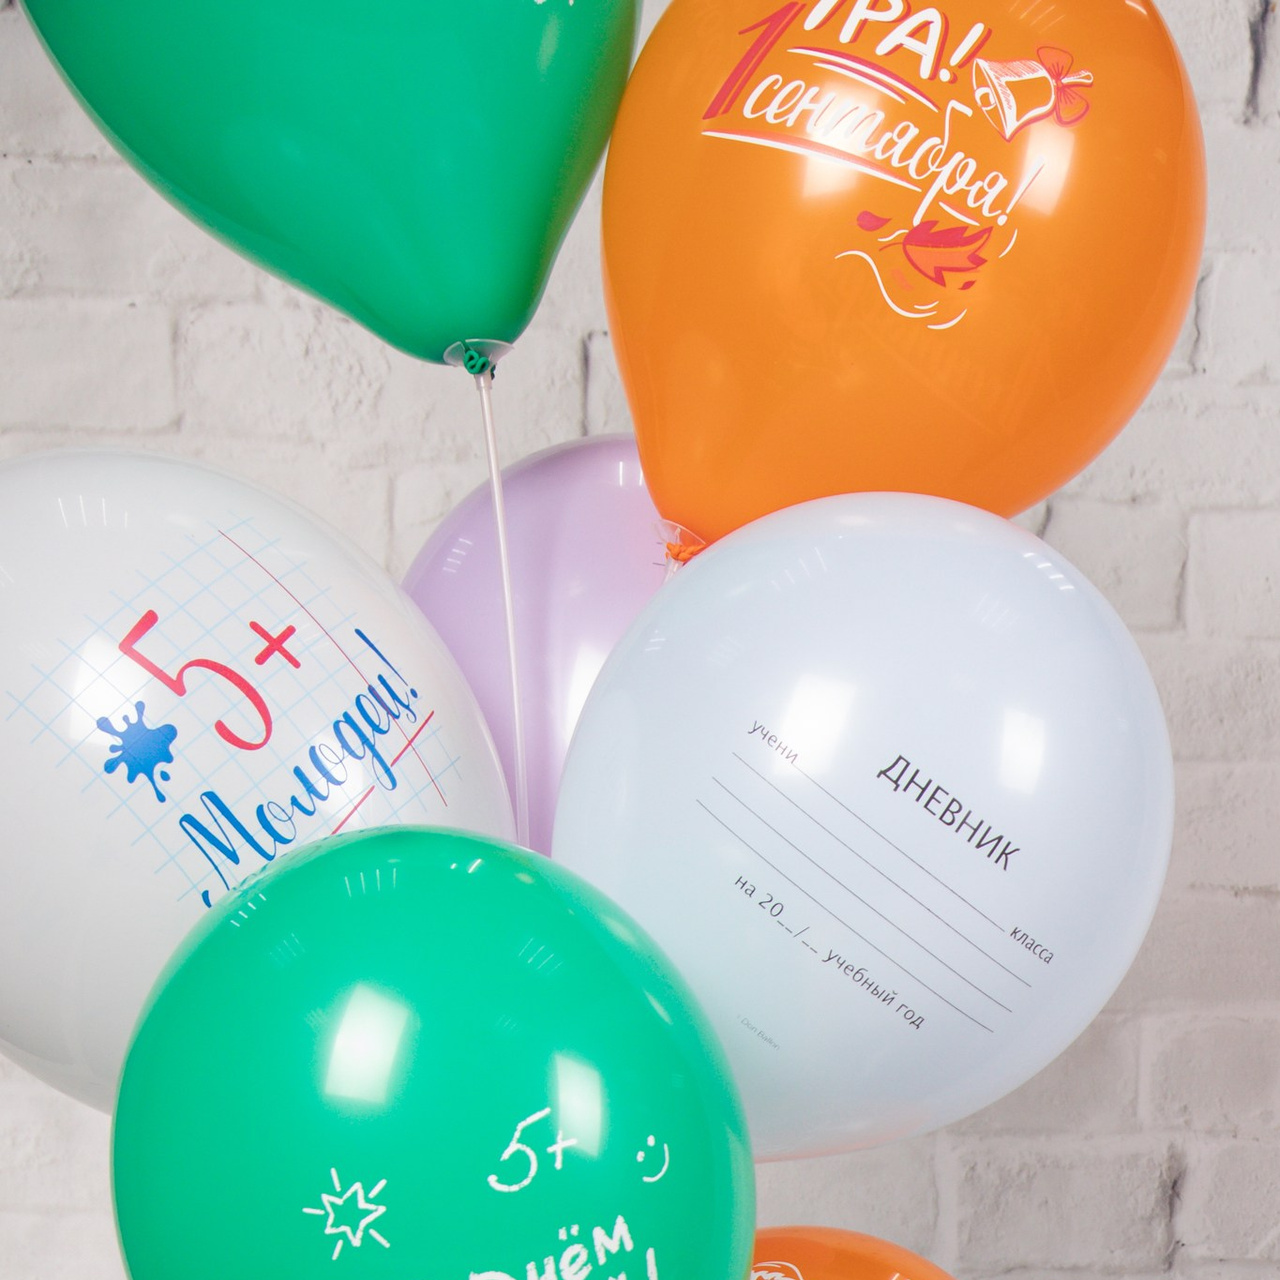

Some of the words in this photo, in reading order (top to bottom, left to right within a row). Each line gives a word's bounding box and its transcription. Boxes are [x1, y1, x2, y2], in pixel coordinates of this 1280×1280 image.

[702, 1, 808, 121] 1
[743, 73, 1045, 227] сентября!
[118, 608, 302, 751] 5+
[179, 628, 420, 908] Молодец!
[748, 720, 799, 765] учени
[1010, 926, 1054, 964] класса
[877, 754, 1021, 871] ДНЕВНИК
[734, 875, 757, 898] на
[821, 948, 898, 1006] учебный
[895, 1002, 926, 1030] год
[487, 1107, 578, 1192] 5+
